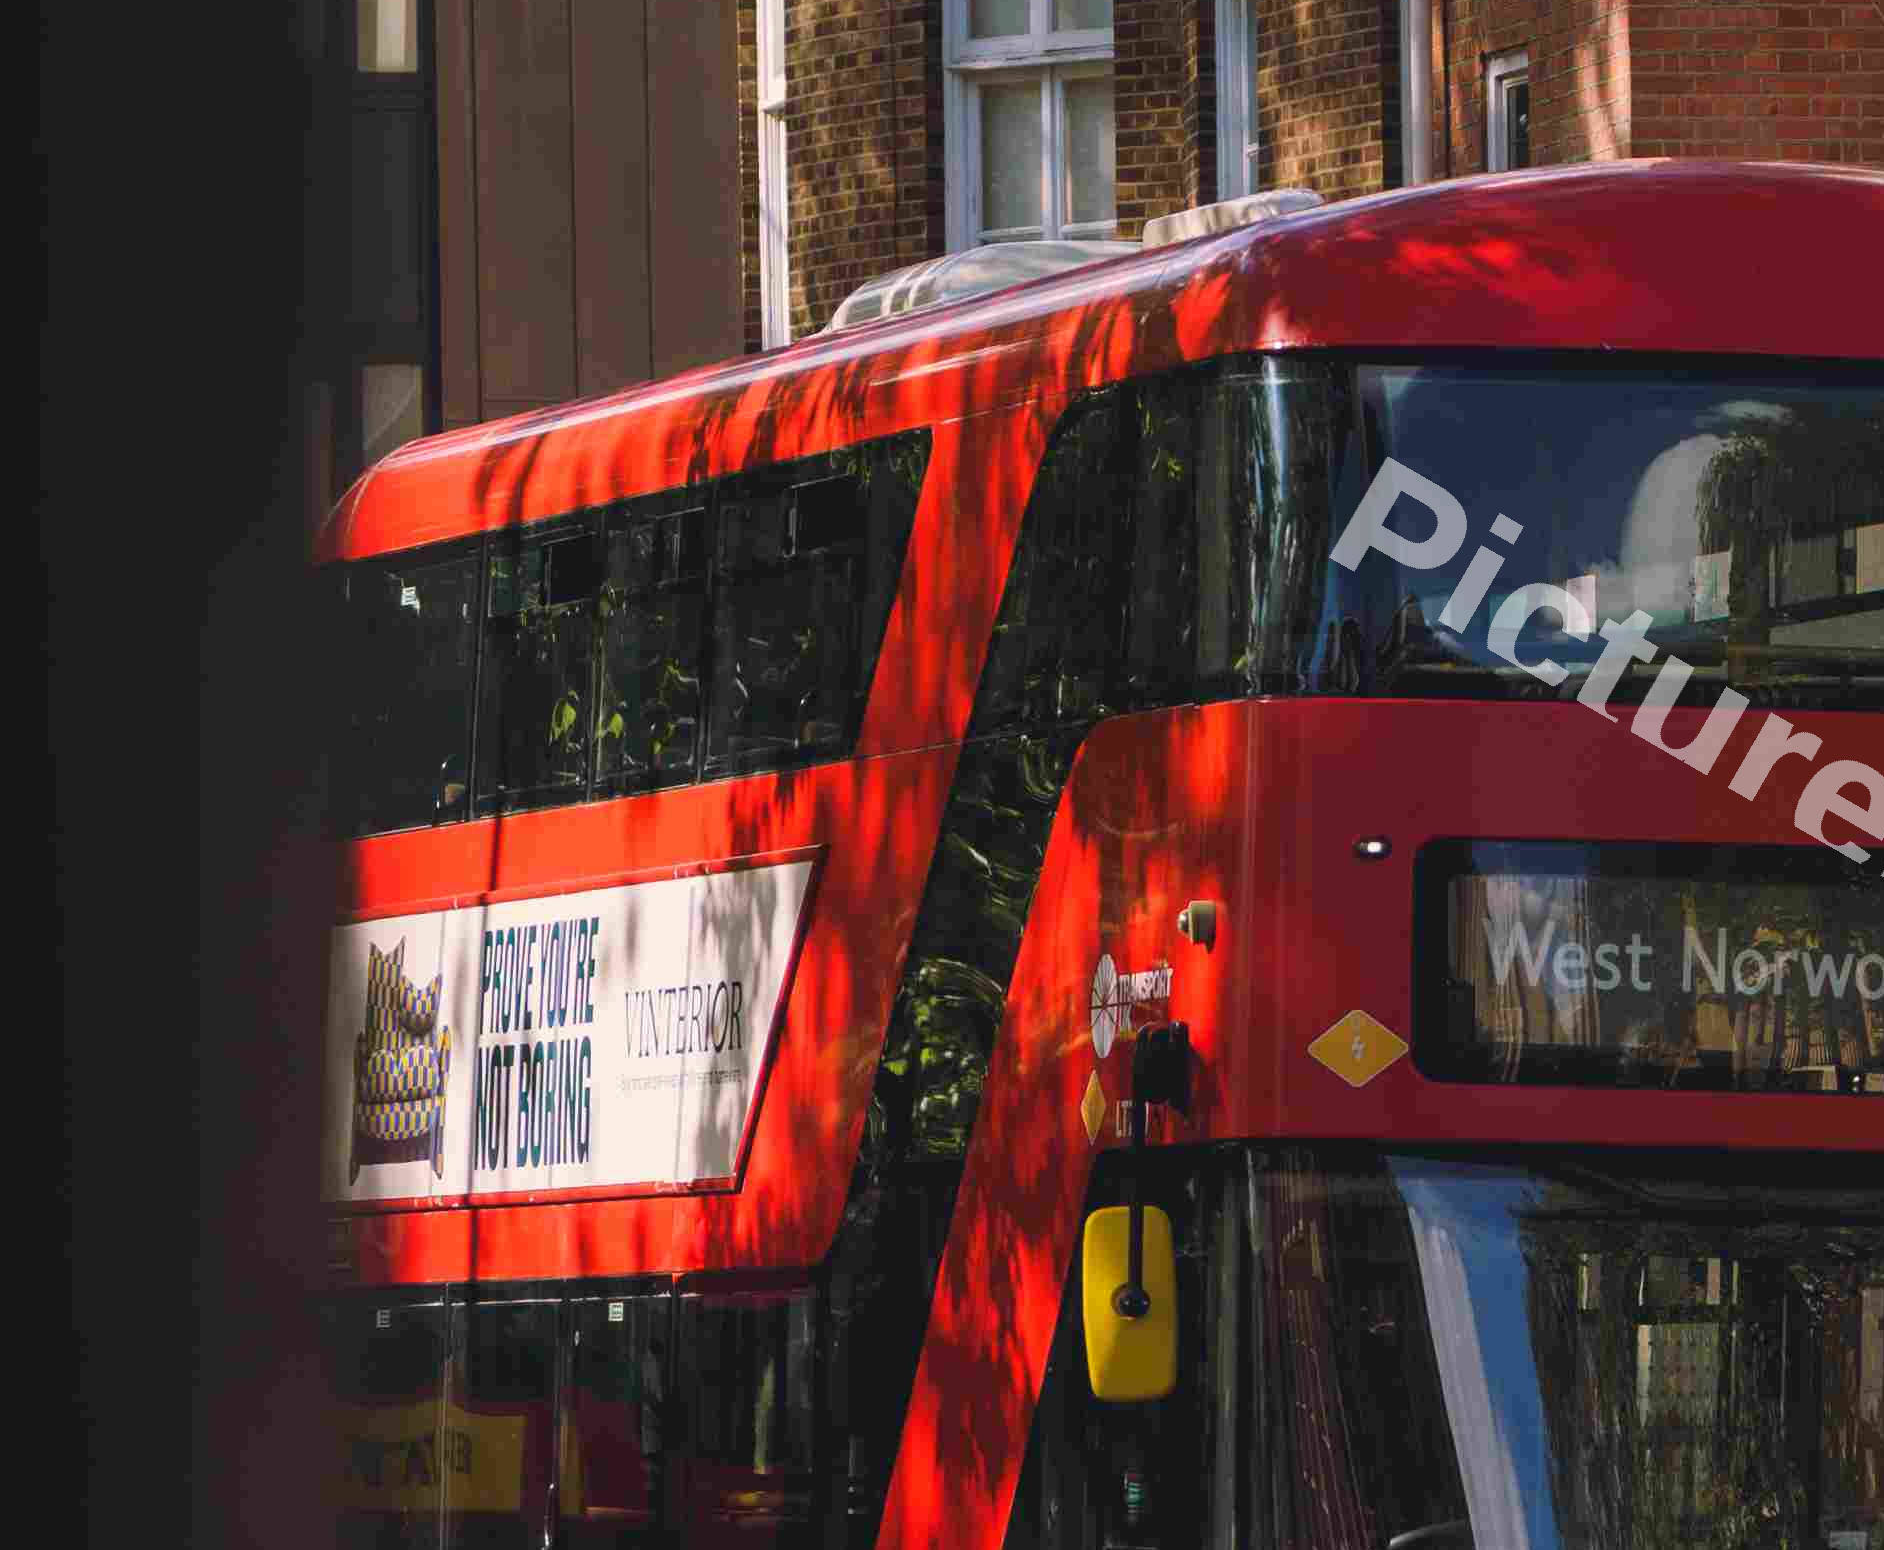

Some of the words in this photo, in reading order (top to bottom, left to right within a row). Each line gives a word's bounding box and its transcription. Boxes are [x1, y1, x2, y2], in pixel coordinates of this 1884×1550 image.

[480, 925, 537, 1036] PROVE
[536, 916, 600, 1029] YOU'RE
[1481, 916, 1653, 992] West
[625, 981, 743, 1058] VINTERIOR
[474, 1044, 515, 1171] NOT
[515, 1036, 592, 1169] BORING
